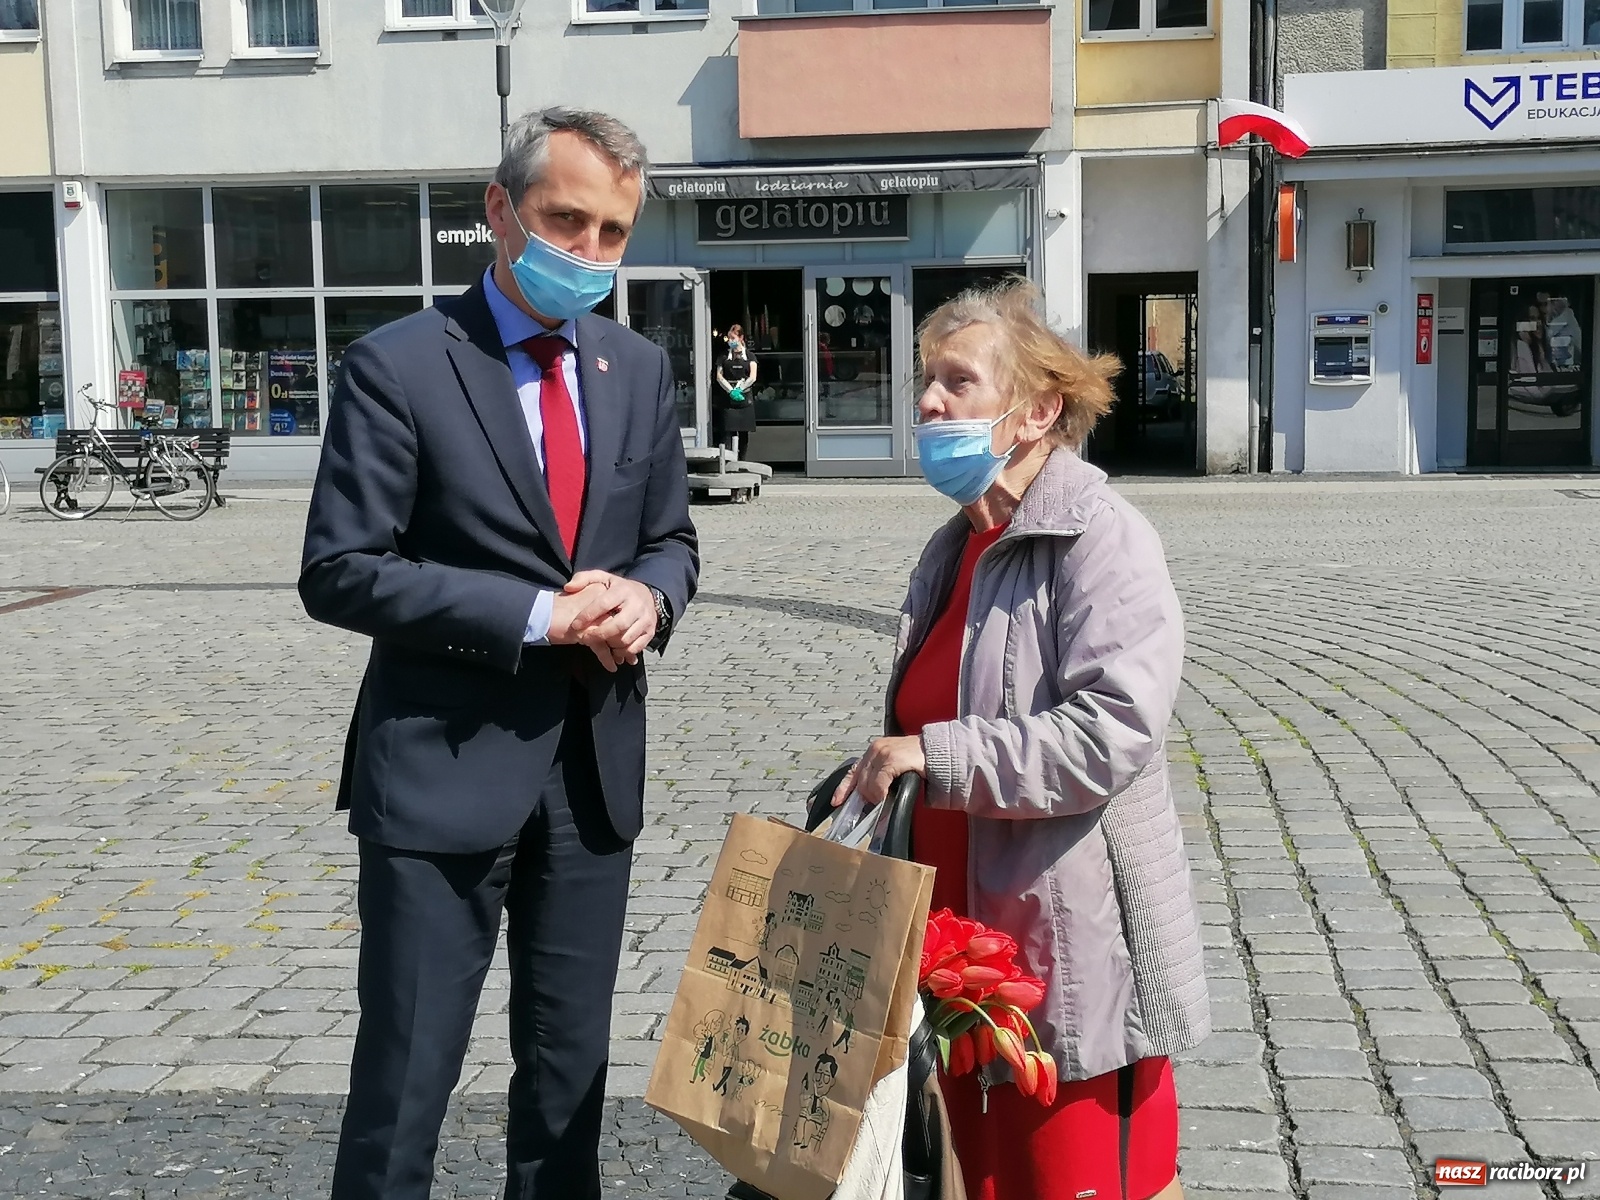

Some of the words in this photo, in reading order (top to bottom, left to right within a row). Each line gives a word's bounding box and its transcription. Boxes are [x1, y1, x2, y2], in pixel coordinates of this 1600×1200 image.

[1529, 72, 1600, 101] TEB
[668, 181, 726, 196] gelatopiu
[755, 179, 849, 192] lodziarnia
[880, 174, 939, 190] gelatopiu
[715, 199, 891, 237] gelatopiu
[758, 1024, 811, 1058] żabka
